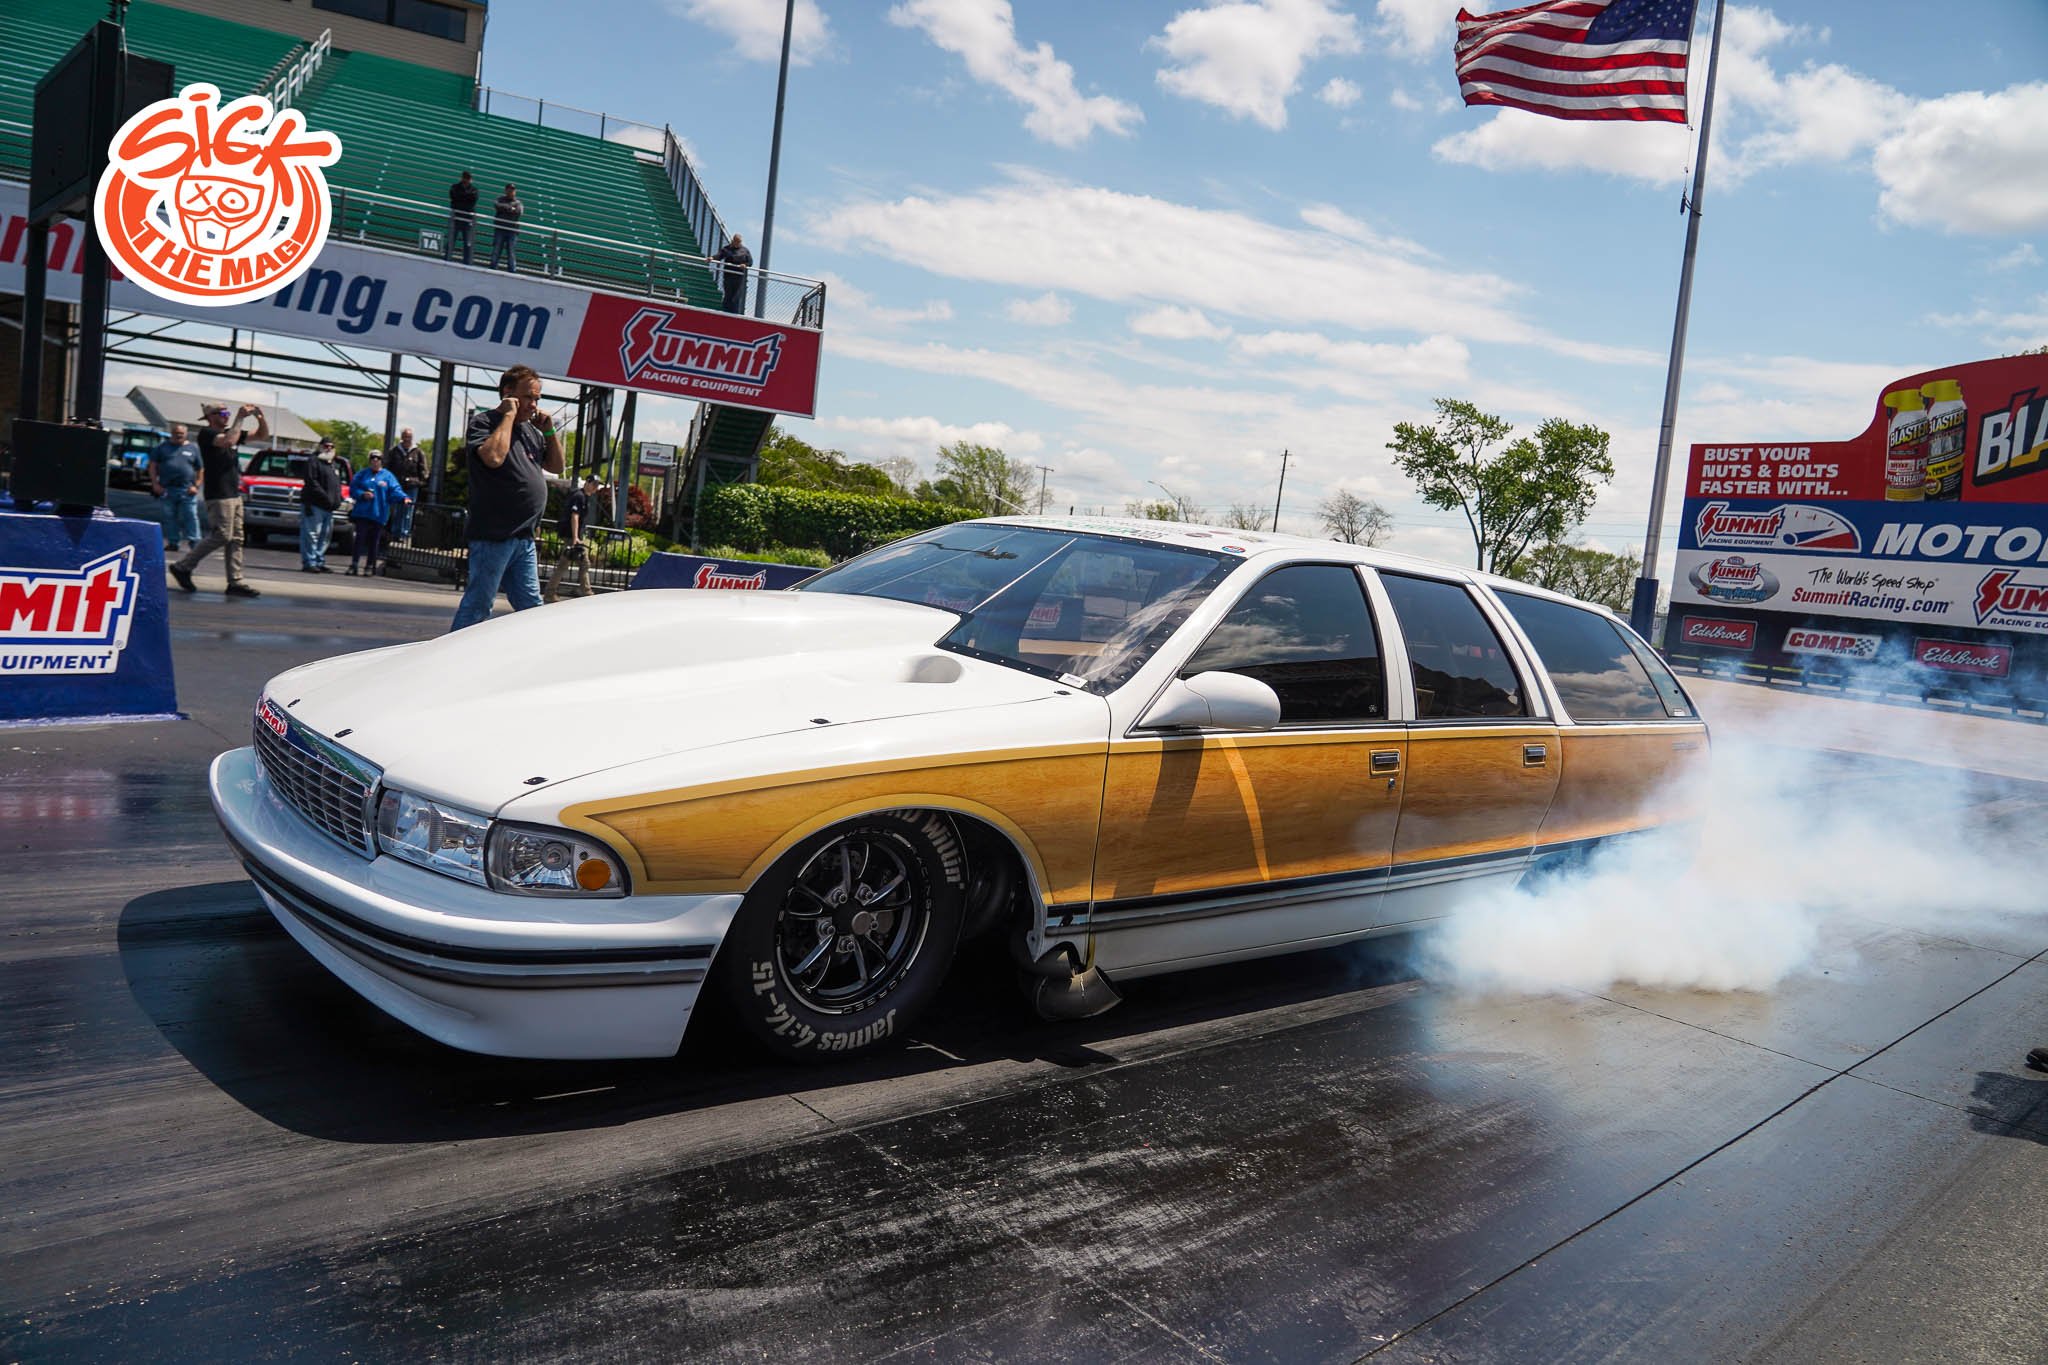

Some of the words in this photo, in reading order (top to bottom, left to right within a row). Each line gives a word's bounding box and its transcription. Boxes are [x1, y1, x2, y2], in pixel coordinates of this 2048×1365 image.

[641, 370, 689, 386] RACING
[691, 378, 763, 397] EQUIPMENT
[1704, 447, 1753, 461] BUST
[1758, 447, 1811, 461] YOUR
[1702, 464, 1752, 478] NUTS
[1757, 464, 1772, 478] &
[1778, 463, 1839, 478] BOLTS
[1700, 481, 1771, 494] FASTER
[1777, 481, 1848, 495] WITH...
[1707, 537, 1733, 545] RACING
[1734, 538, 1775, 546] EQUIPMENT
[1871, 523, 2048, 562] MOTO
[1808, 567, 1833, 585] The
[1836, 569, 1869, 587] World's
[1872, 573, 1904, 594] Speed
[1906, 576, 1935, 595] Shop
[1792, 587, 1949, 614] SummitRacing.com
[1990, 617, 2031, 627] RACING
[1688, 623, 1747, 642] Edelbrock
[1788, 632, 1857, 651] COMP
[1, 655, 111, 669] UIPMENT
[1922, 647, 2000, 669] Edelbrock
[817, 1008, 896, 1051] James
